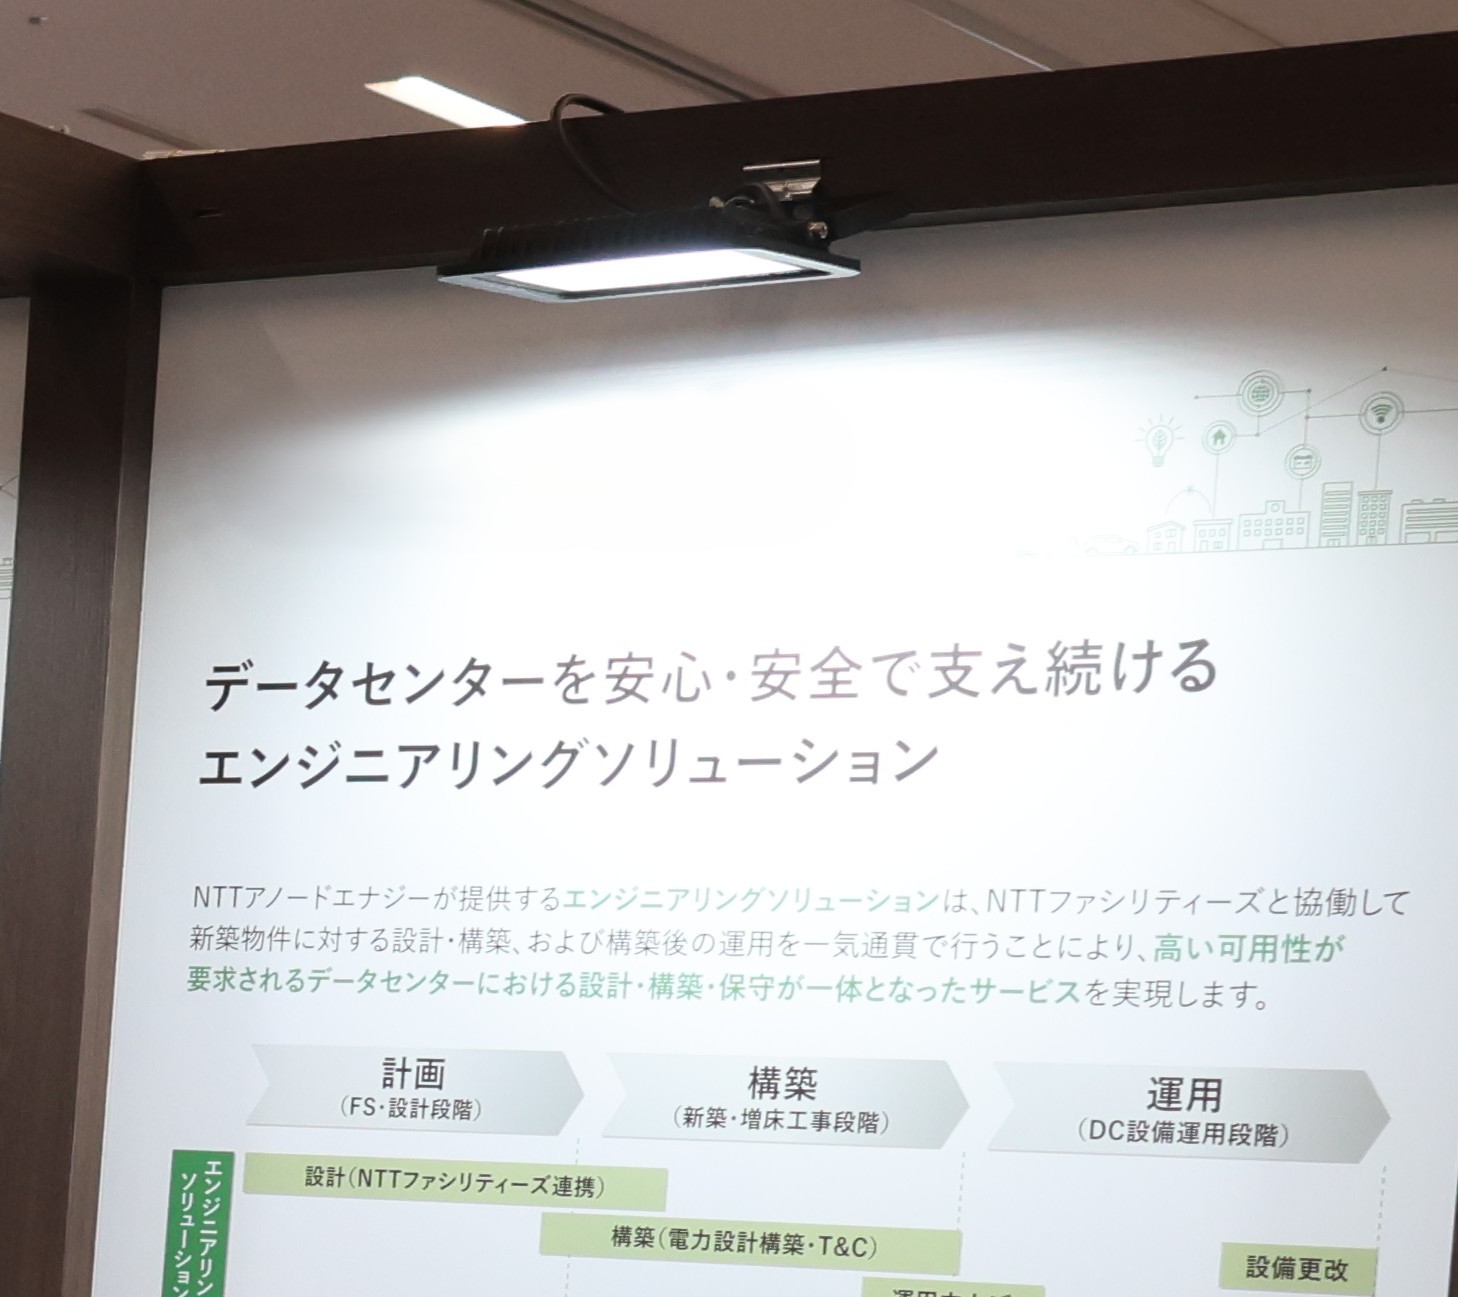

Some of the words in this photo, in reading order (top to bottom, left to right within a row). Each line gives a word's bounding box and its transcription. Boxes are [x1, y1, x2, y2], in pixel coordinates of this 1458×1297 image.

[204, 637, 1219, 711] データセンターを安心・安全で支え続ける
[197, 737, 940, 790] エンジニアリングソリューション
[381, 1056, 446, 1092] 計画
[748, 1065, 819, 1102] 構築
[1146, 1075, 1224, 1115] 運用
[1245, 1254, 1350, 1284] 設備更改
